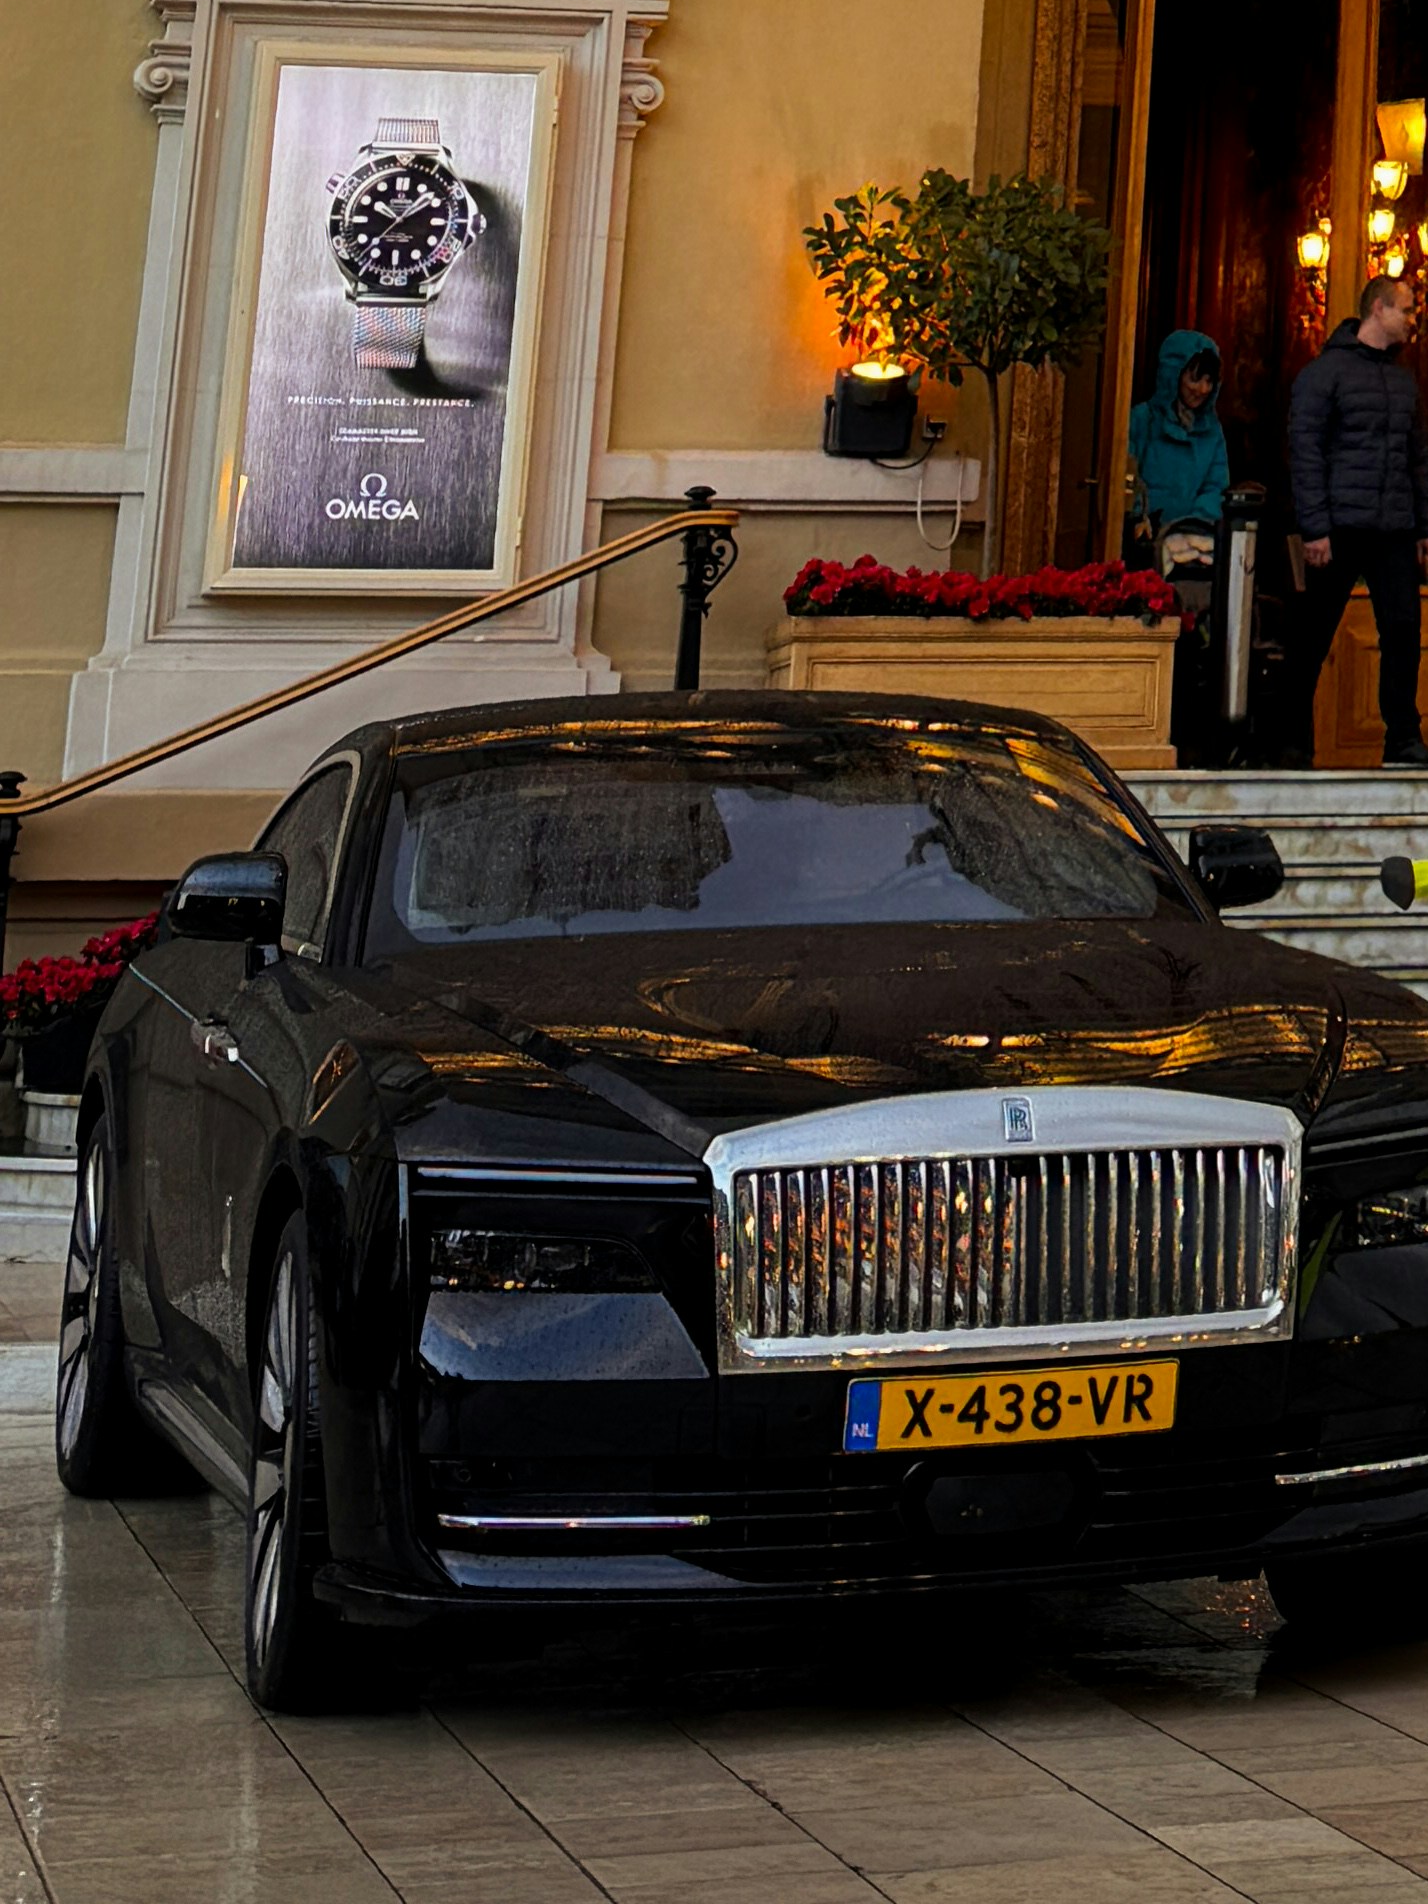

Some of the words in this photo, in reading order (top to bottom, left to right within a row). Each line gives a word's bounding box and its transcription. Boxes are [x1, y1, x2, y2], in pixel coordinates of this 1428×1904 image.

[325, 498, 420, 521] OMEGA
[852, 1422, 875, 1439] NL
[900, 1372, 1154, 1439] X-438-VR
